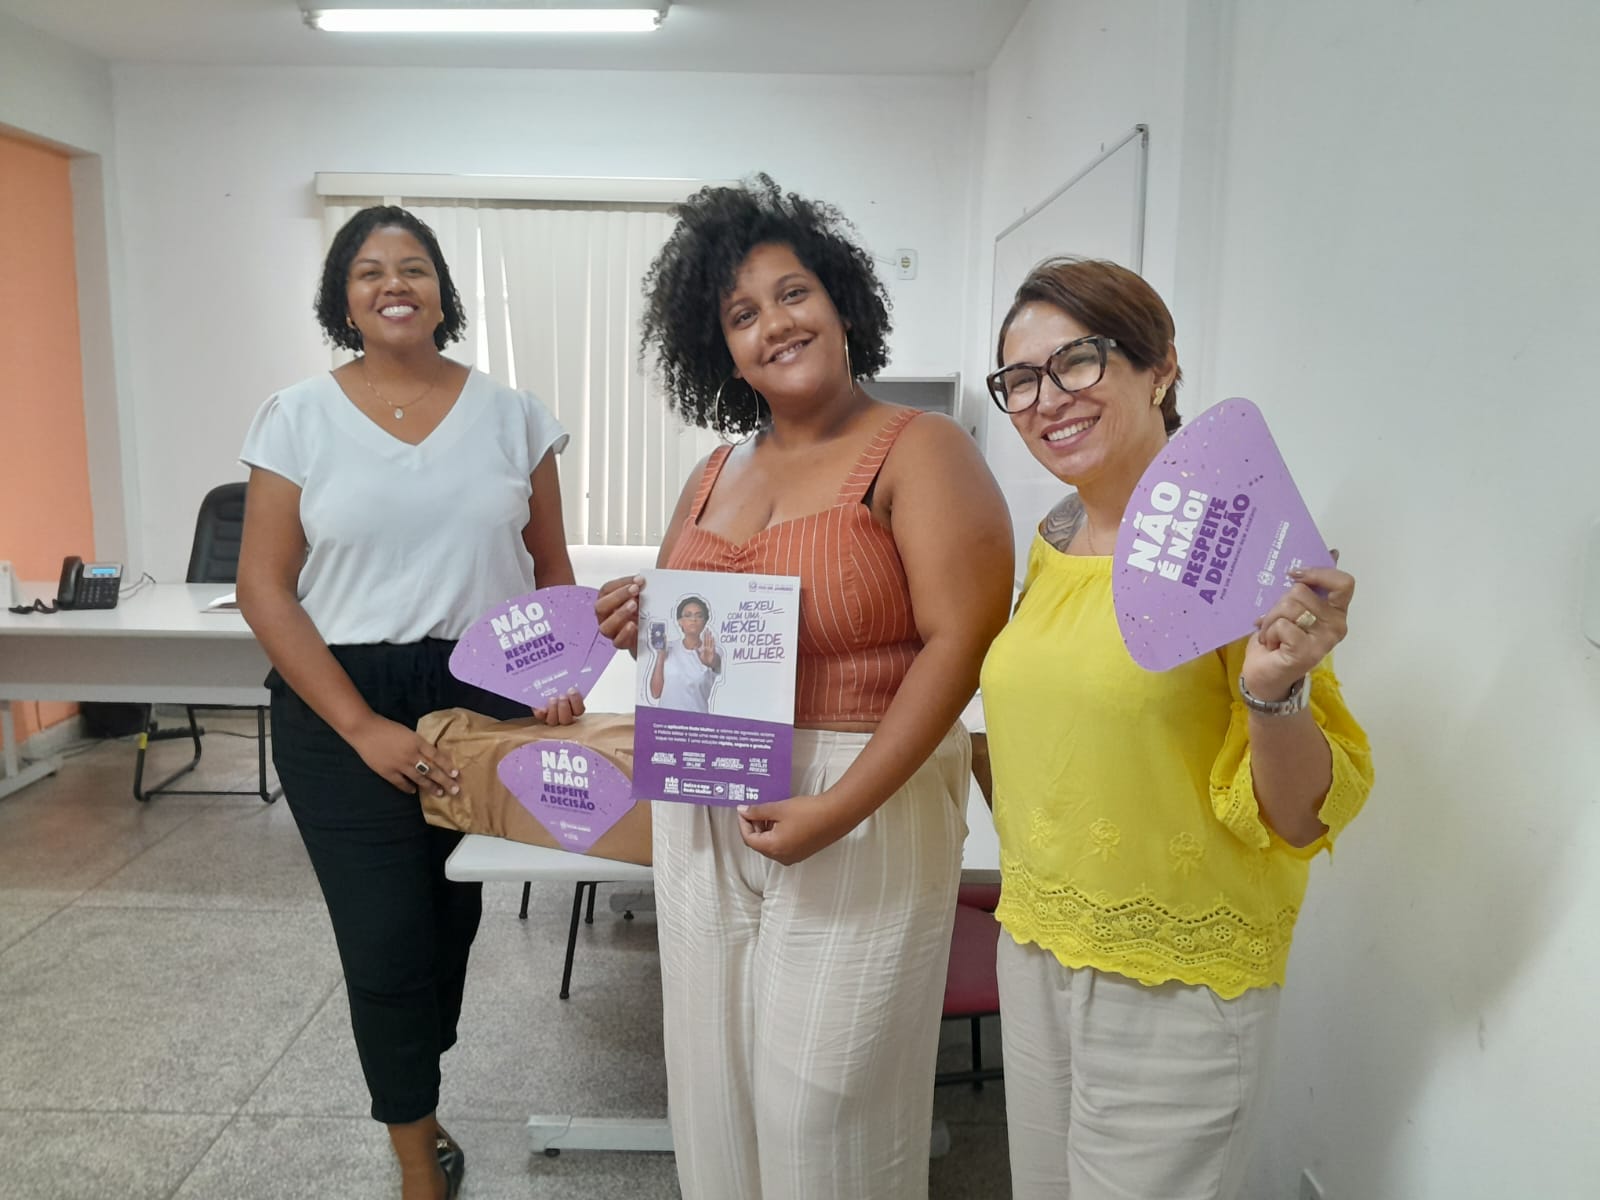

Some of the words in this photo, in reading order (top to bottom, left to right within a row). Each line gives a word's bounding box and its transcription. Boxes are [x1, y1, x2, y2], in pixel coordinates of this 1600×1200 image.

[1127, 481, 1181, 573] NÃO
[1167, 489, 1208, 559] NÃO!
[1182, 497, 1227, 587] RESPEITE
[1205, 493, 1250, 585] DECISÃO
[1157, 560, 1182, 581] É
[739, 600, 774, 611] MEXEU
[1199, 589, 1217, 605] A
[490, 602, 544, 636] NÃO
[721, 620, 766, 633] MEXEU
[499, 633, 512, 650] É
[512, 620, 551, 645] NÃO!
[504, 632, 556, 660] RESPEITE
[720, 634, 738, 643] COM
[740, 634, 746, 643] O
[748, 633, 782, 646] REDE
[506, 663, 514, 673] A
[515, 642, 565, 669] DECISÃO
[733, 647, 785, 660] MULHER
[541, 749, 588, 774] NÃO
[542, 768, 551, 782] É
[554, 771, 589, 788] NÃO!
[540, 794, 548, 802] A
[550, 795, 595, 811] DECISÃO
[544, 783, 589, 799] RESPEITE
